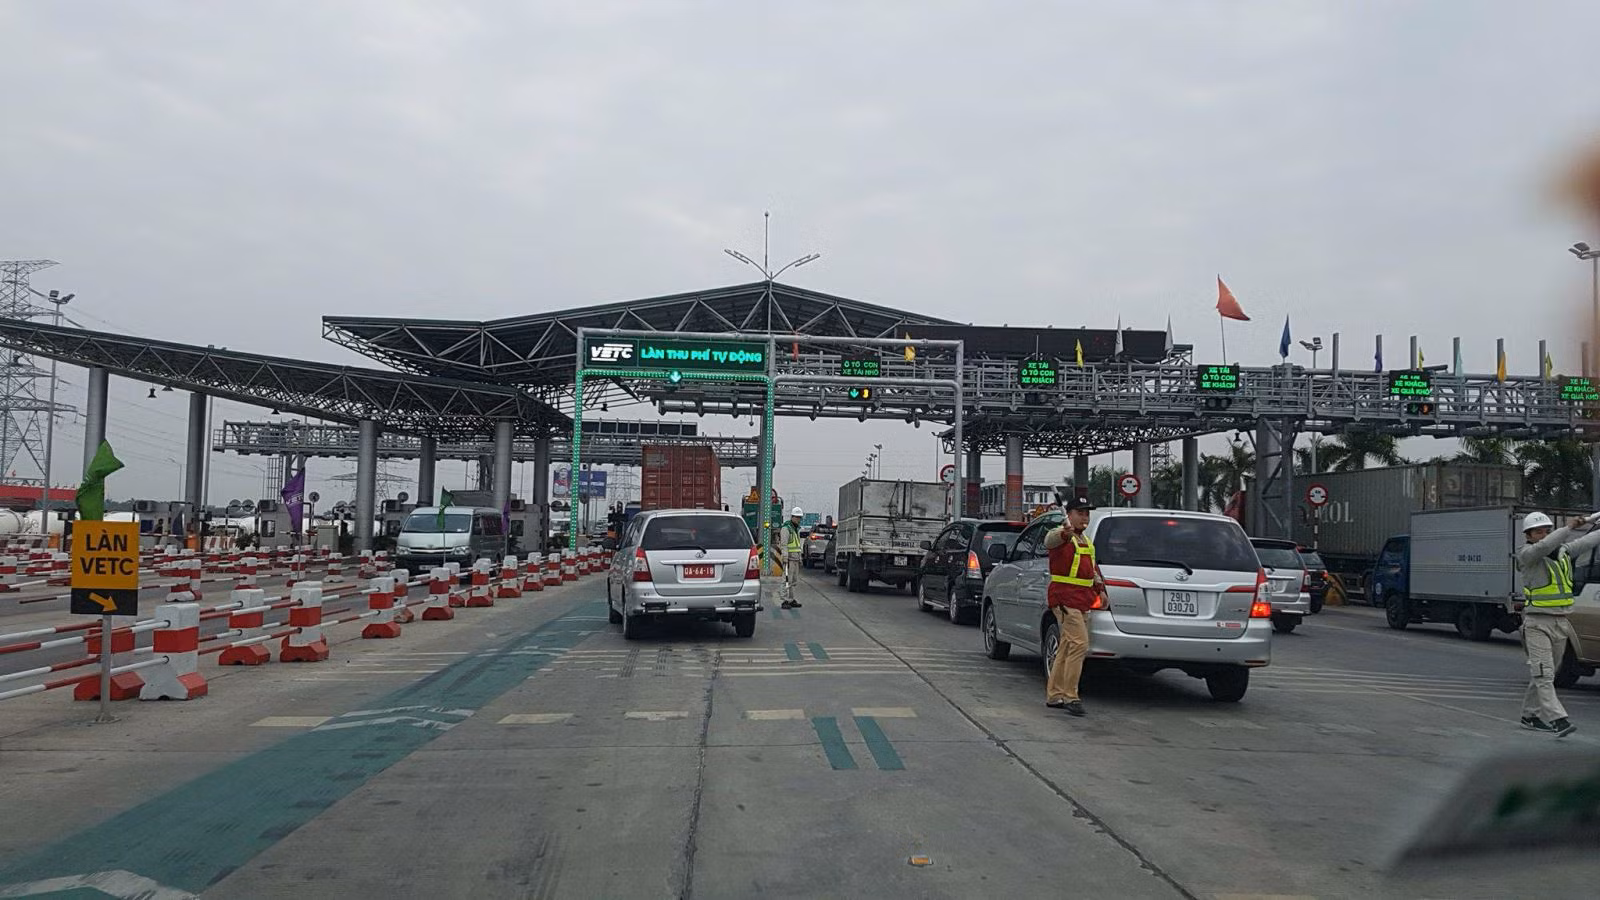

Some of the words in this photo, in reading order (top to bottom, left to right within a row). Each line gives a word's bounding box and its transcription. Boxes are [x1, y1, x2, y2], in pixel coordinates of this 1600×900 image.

[591, 345, 634, 359] VETC
[641, 346, 664, 359] LÀN
[667, 349, 689, 360] THU
[691, 348, 711, 360] PHÍ
[85, 529, 128, 552] LÀN
[80, 557, 135, 576] VETC
[1170, 592, 1191, 603] 29LD
[1167, 602, 1195, 613] 030.70
